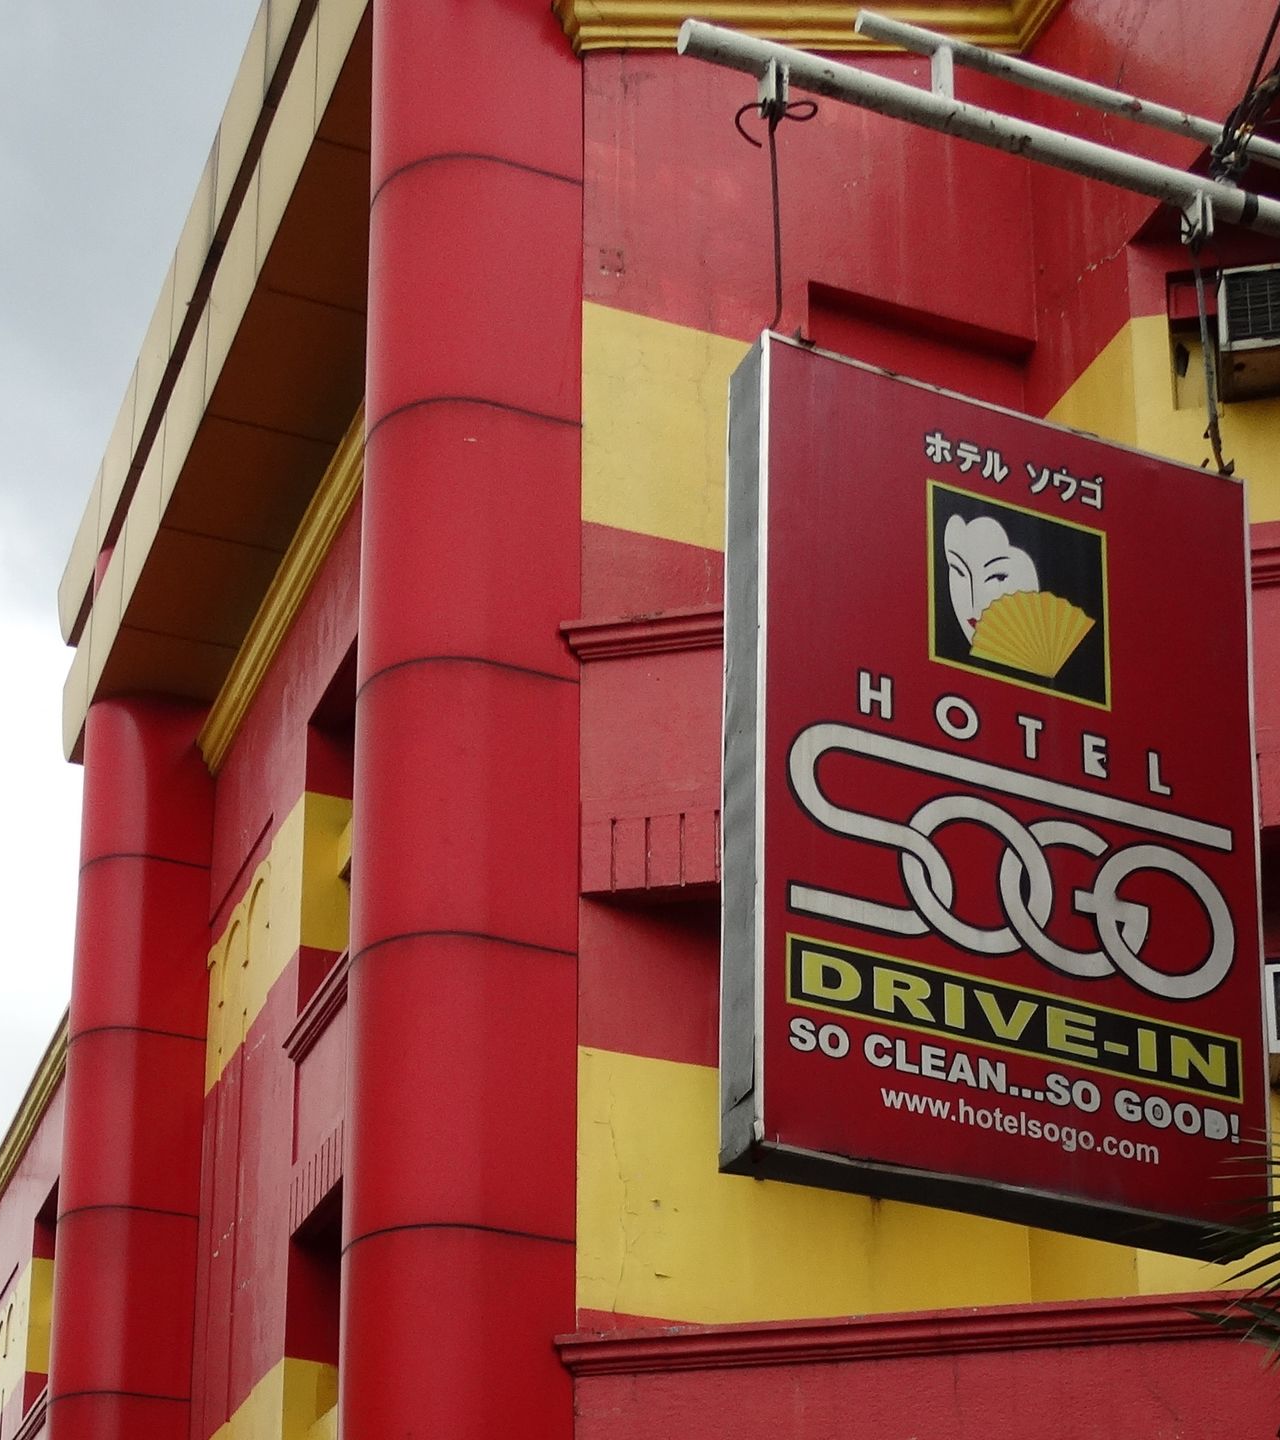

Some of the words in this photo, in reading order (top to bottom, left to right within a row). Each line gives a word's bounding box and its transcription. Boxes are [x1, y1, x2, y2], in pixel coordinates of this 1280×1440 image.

[925, 432, 1009, 484] ホテル
[1026, 461, 1104, 510] ソウゴ
[858, 671, 1172, 796] HOTEL
[788, 722, 1236, 1000] SOGO
[788, 1017, 850, 1059] SO
[1113, 1088, 1241, 1144] GOOD!
[801, 949, 1227, 1088] DRIVE-IN
[879, 1083, 1160, 1165] www.hotelsogo.com
